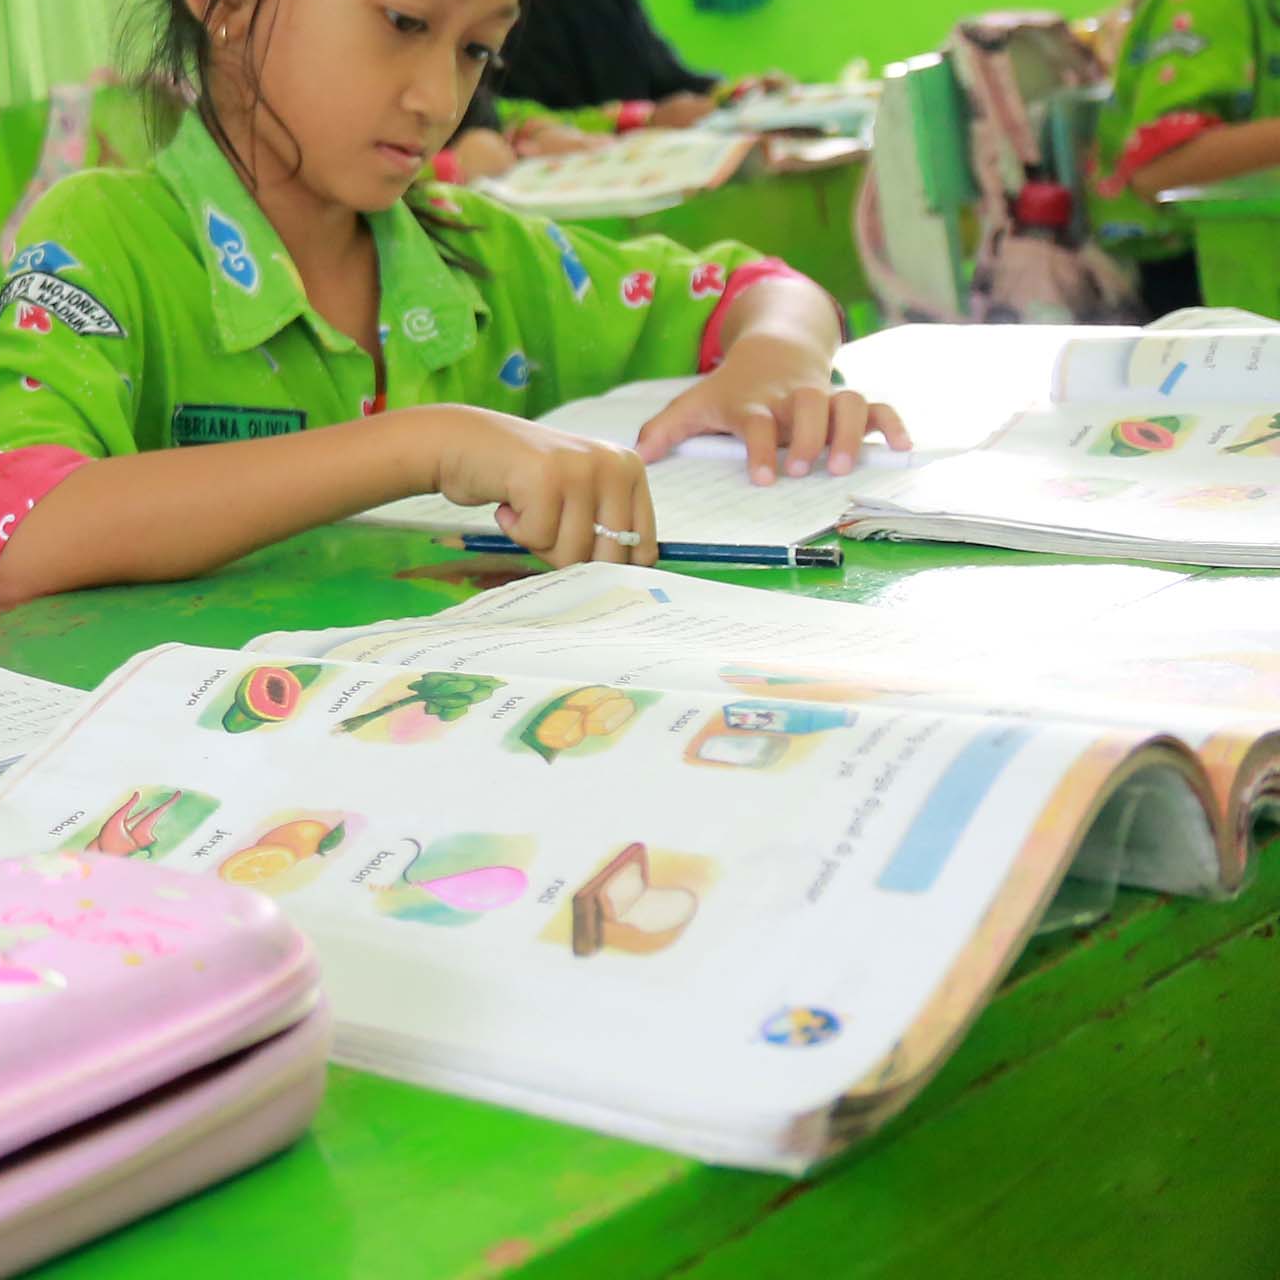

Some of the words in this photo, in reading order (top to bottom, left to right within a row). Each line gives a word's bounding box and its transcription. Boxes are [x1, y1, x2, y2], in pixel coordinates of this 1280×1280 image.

[36, 293, 88, 331] MADIUN
[39, 278, 113, 330] MOJOREJO
[178, 415, 241, 439] BRIANA
[184, 668, 228, 708] pepaya
[328, 679, 375, 715] bayam
[490, 695, 524, 721] tahu
[667, 706, 700, 734] susu
[47, 809, 86, 837] cabai
[191, 828, 233, 859] jeruk
[351, 850, 396, 888] balon
